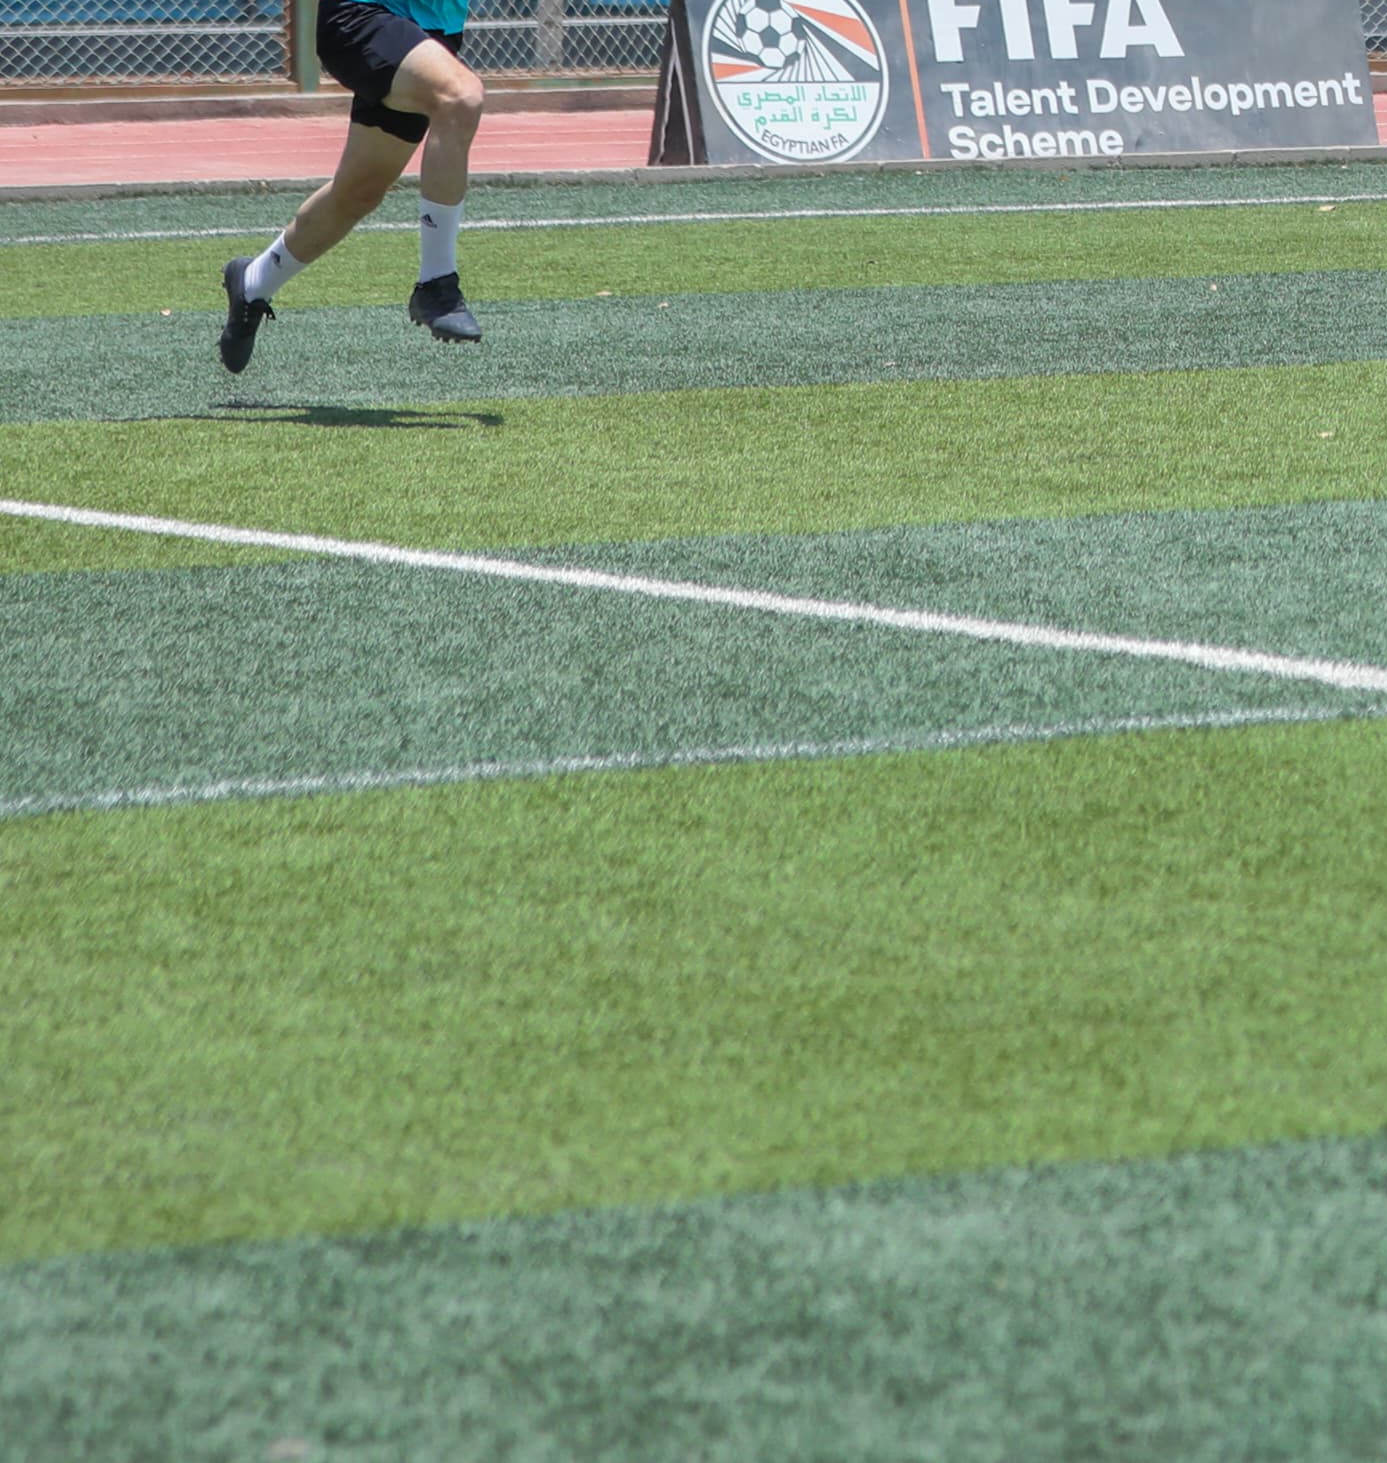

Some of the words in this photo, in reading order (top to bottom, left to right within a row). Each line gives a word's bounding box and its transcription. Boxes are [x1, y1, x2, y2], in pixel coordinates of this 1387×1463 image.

[814, 85, 867, 102] الاتحاد
[941, 81, 1079, 117] Talent
[1086, 72, 1364, 115] Development
[754, 106, 803, 133] القدم
[811, 106, 857, 130] لكرة
[761, 129, 830, 154] EGYPTIAN
[830, 133, 849, 150] FA
[948, 126, 1124, 160] Scheme
